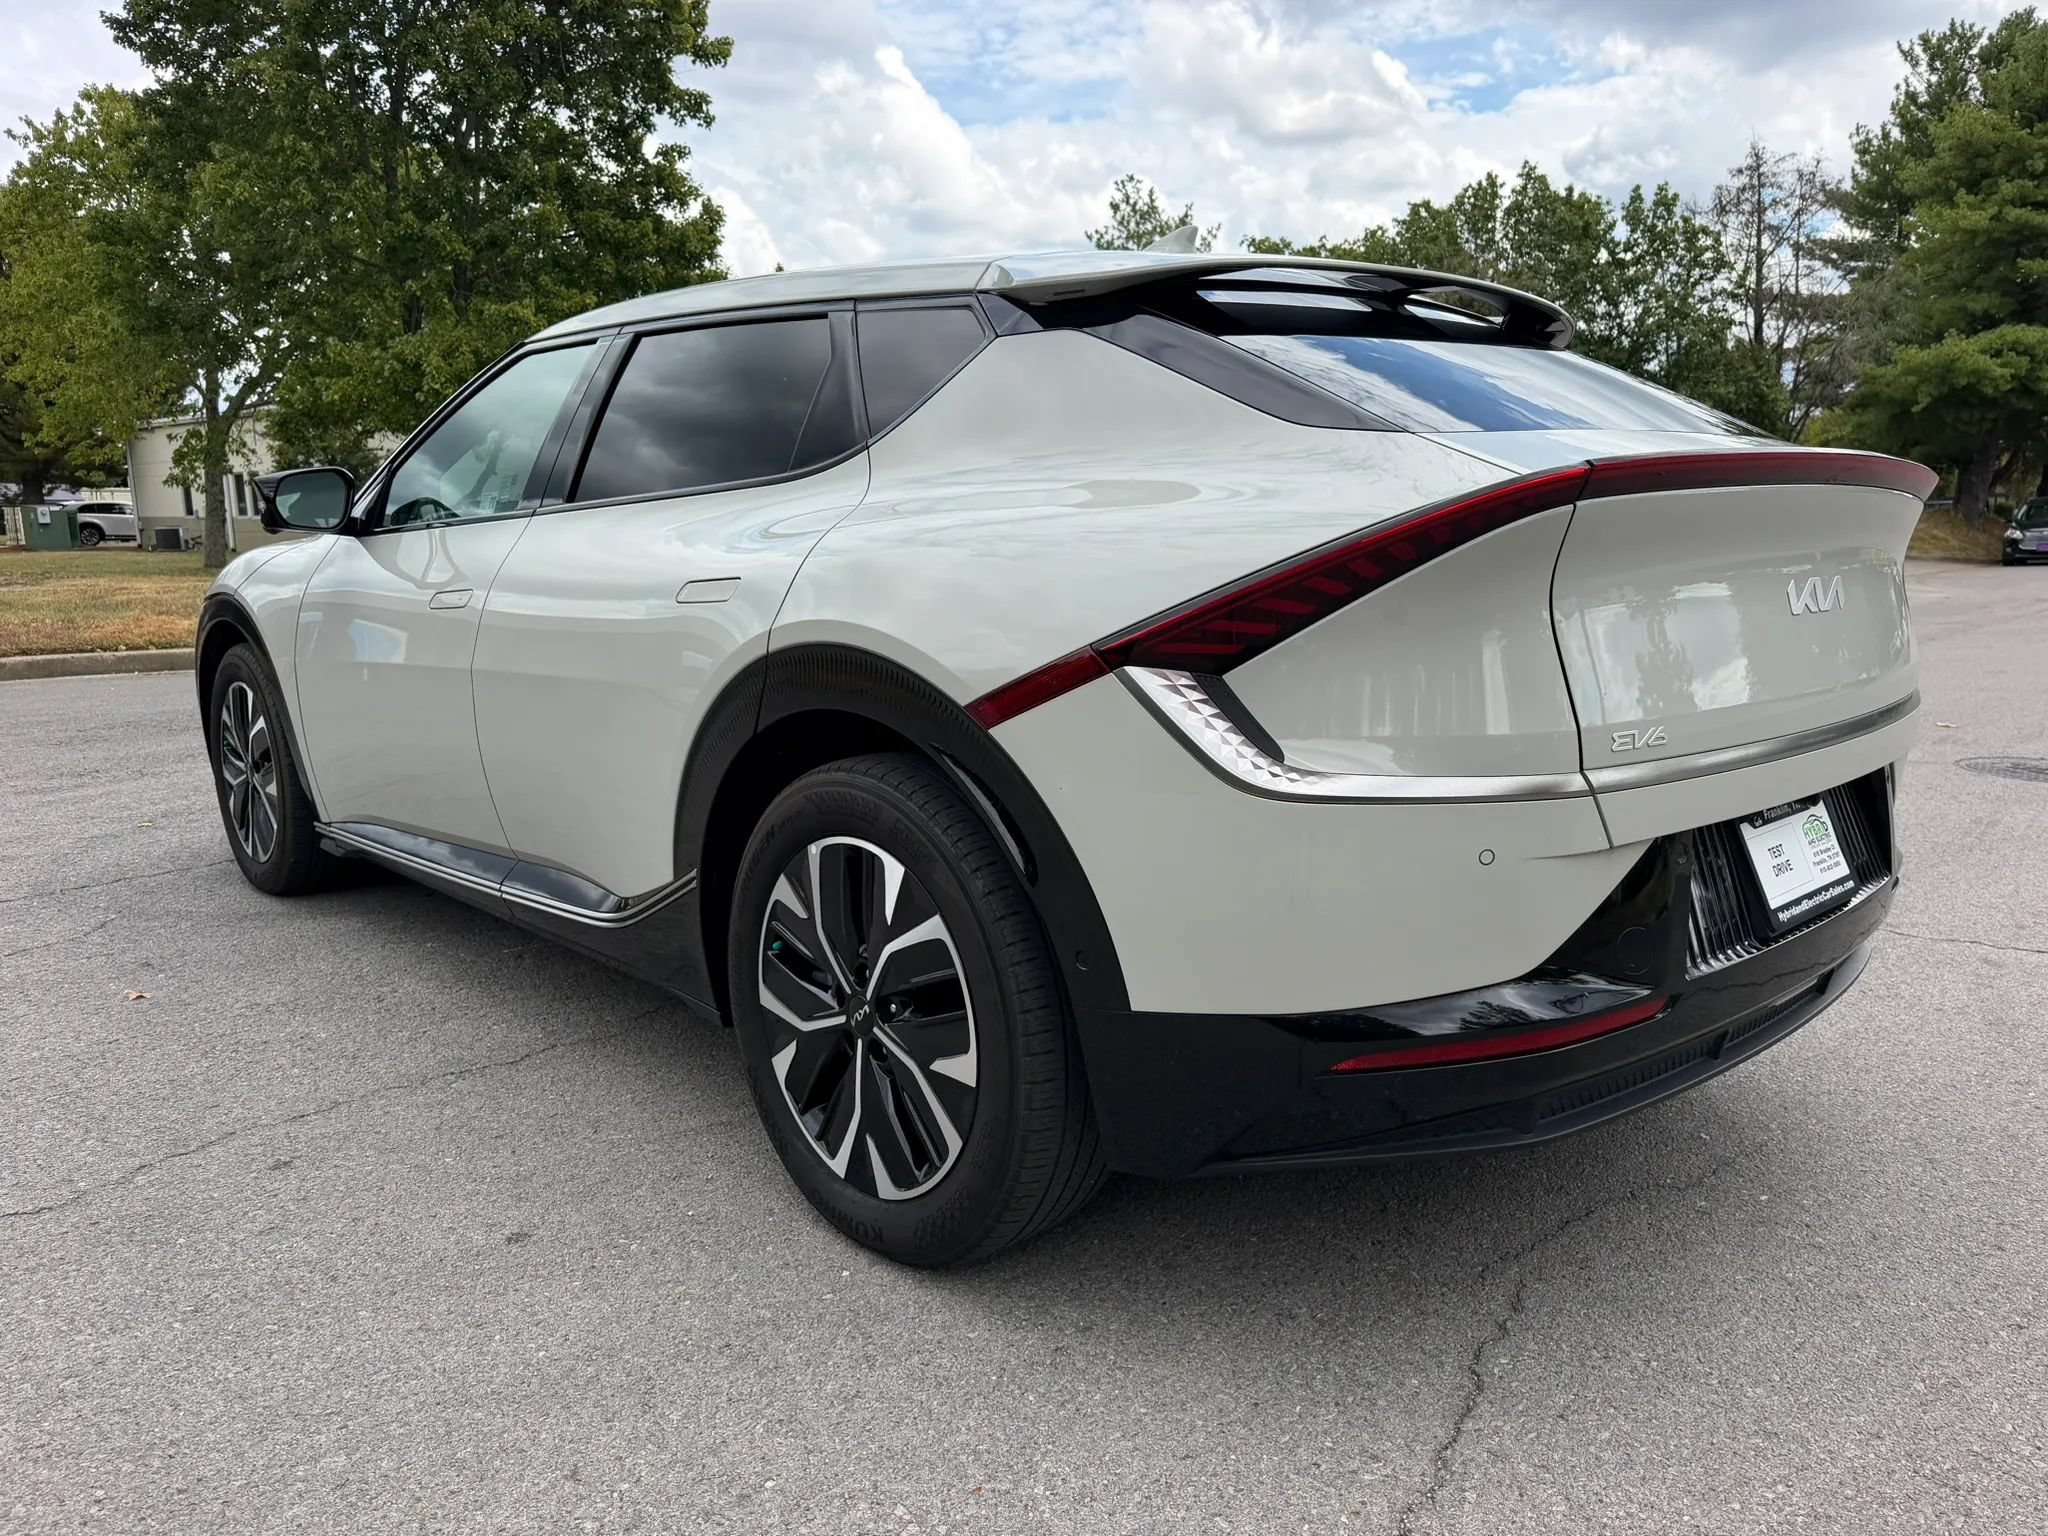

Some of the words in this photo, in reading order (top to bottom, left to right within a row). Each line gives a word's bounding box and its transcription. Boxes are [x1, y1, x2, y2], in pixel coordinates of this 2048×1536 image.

[1611, 726, 1668, 752] EV6
[1767, 843, 1785, 860] TEST
[1772, 859, 1794, 877] DRIVE
[1777, 880, 1855, 922] HybridandElectricCarSales.com
